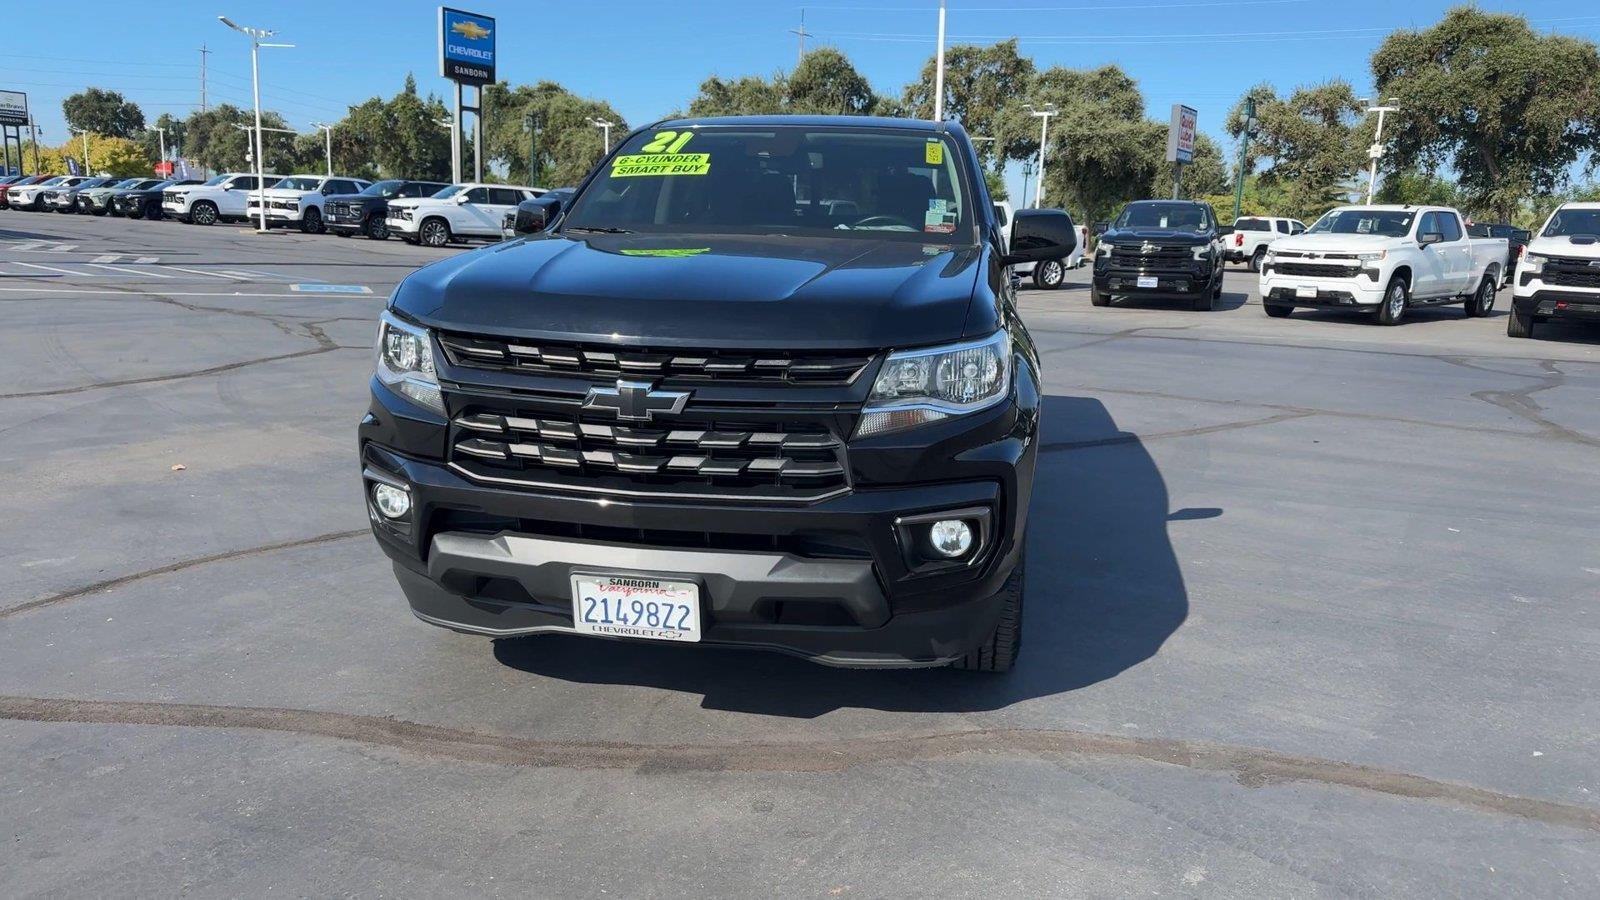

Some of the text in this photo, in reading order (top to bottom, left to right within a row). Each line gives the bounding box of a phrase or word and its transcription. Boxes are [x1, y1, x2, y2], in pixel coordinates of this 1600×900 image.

[448, 44, 493, 59] CHEVROLET
[454, 65, 488, 79] SANBORN
[641, 131, 695, 154] 21
[617, 164, 705, 175] SMART BUY
[609, 578, 660, 588] SANBORN
[584, 596, 691, 631] 21498Z2
[592, 625, 655, 637] CHEVROLET
